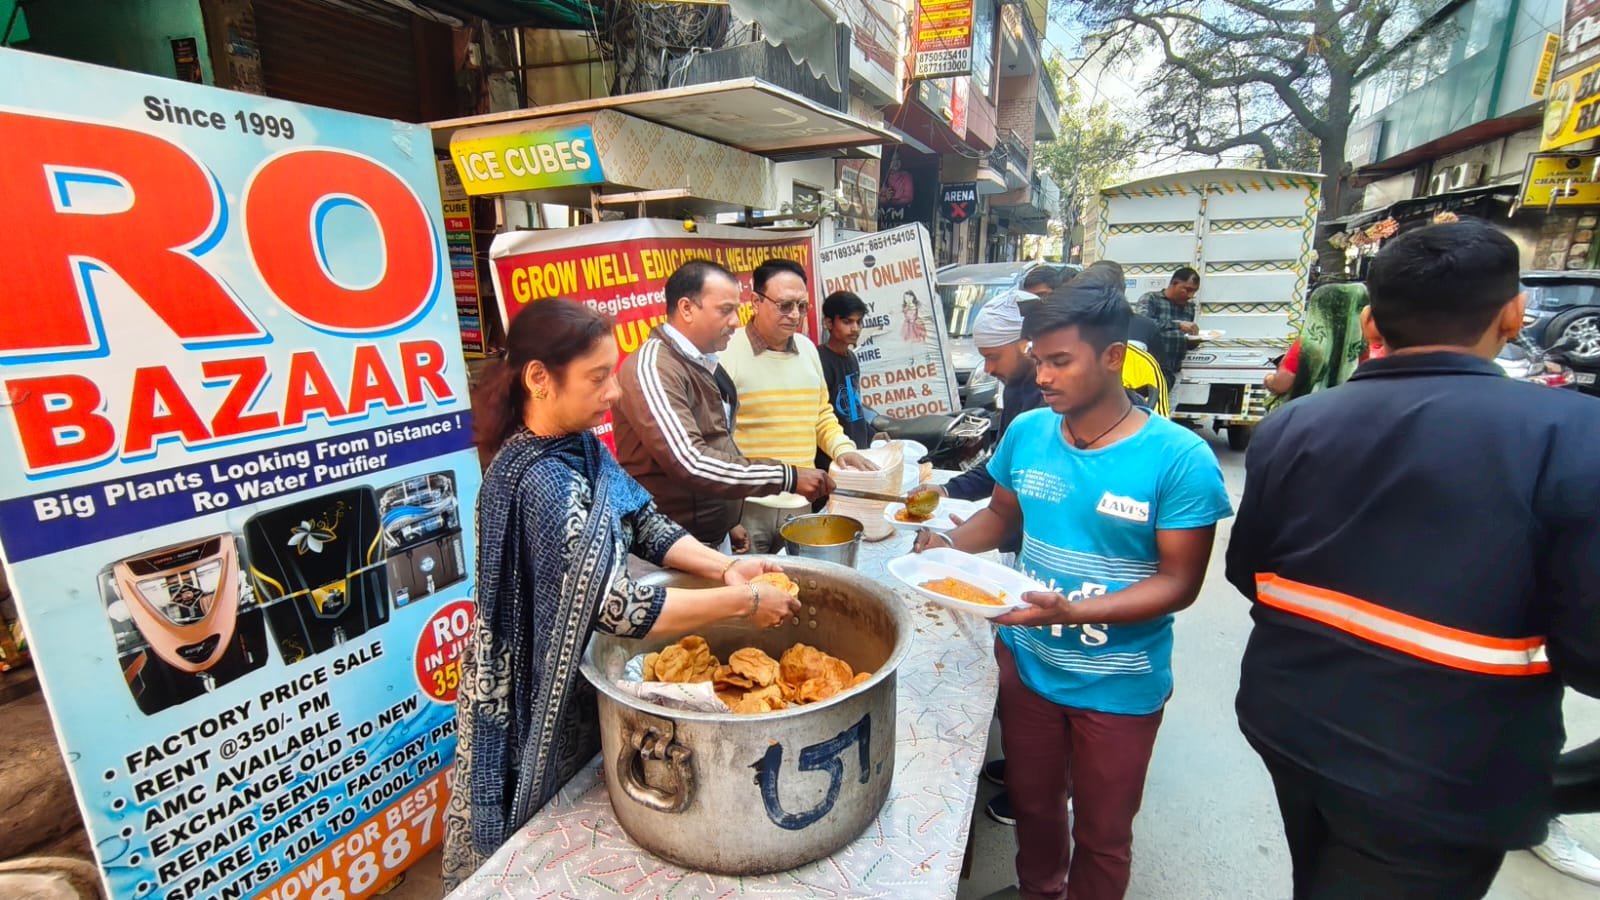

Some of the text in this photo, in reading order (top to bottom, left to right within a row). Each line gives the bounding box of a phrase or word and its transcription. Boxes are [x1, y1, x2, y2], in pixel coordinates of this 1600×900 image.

[143, 95, 295, 140] Since 1999
[459, 138, 592, 182] ICE CUBES
[944, 190, 976, 203] ARENA
[0, 109, 438, 350] RO
[512, 254, 579, 304] GROW
[580, 250, 640, 291] WELL
[583, 287, 667, 316] Registered
[825, 255, 923, 296] PARTY ONLINE
[857, 348, 882, 363] HIRE
[860, 362, 937, 390] OR DANCE
[5, 339, 456, 474] BAZAAR
[862, 384, 933, 407] DRAMA &
[885, 400, 948, 420] SCHOOL
[33, 493, 96, 522] Big
[104, 469, 203, 507] Plants
[211, 448, 312, 484] Looking
[315, 435, 370, 463] From
[374, 417, 453, 448] Distance
[193, 451, 388, 513] Ro Water Purifier
[424, 649, 444, 673] IN
[125, 641, 384, 776] FACTORY PRICE SALE
[134, 692, 332, 807] RENT @350/- PM
[143, 713, 343, 833] AMC AVAILABLE
[150, 695, 419, 863] EXCHANGE OLD TO NEW
[158, 750, 368, 885] REPAIR SERVICES
[166, 844, 254, 900] SPARE
[258, 799, 331, 853] PARTS
[347, 735, 428, 798] FACTORY
[431, 716, 458, 745] PRI
[207, 859, 279, 900] NTS:
[284, 831, 325, 862] 10L
[327, 808, 356, 834] TO
[361, 770, 415, 812] 1000L
[417, 750, 440, 776] PH
[331, 821, 382, 870] FOR
[385, 778, 440, 831] BEST
[310, 804, 438, 900] 8887
